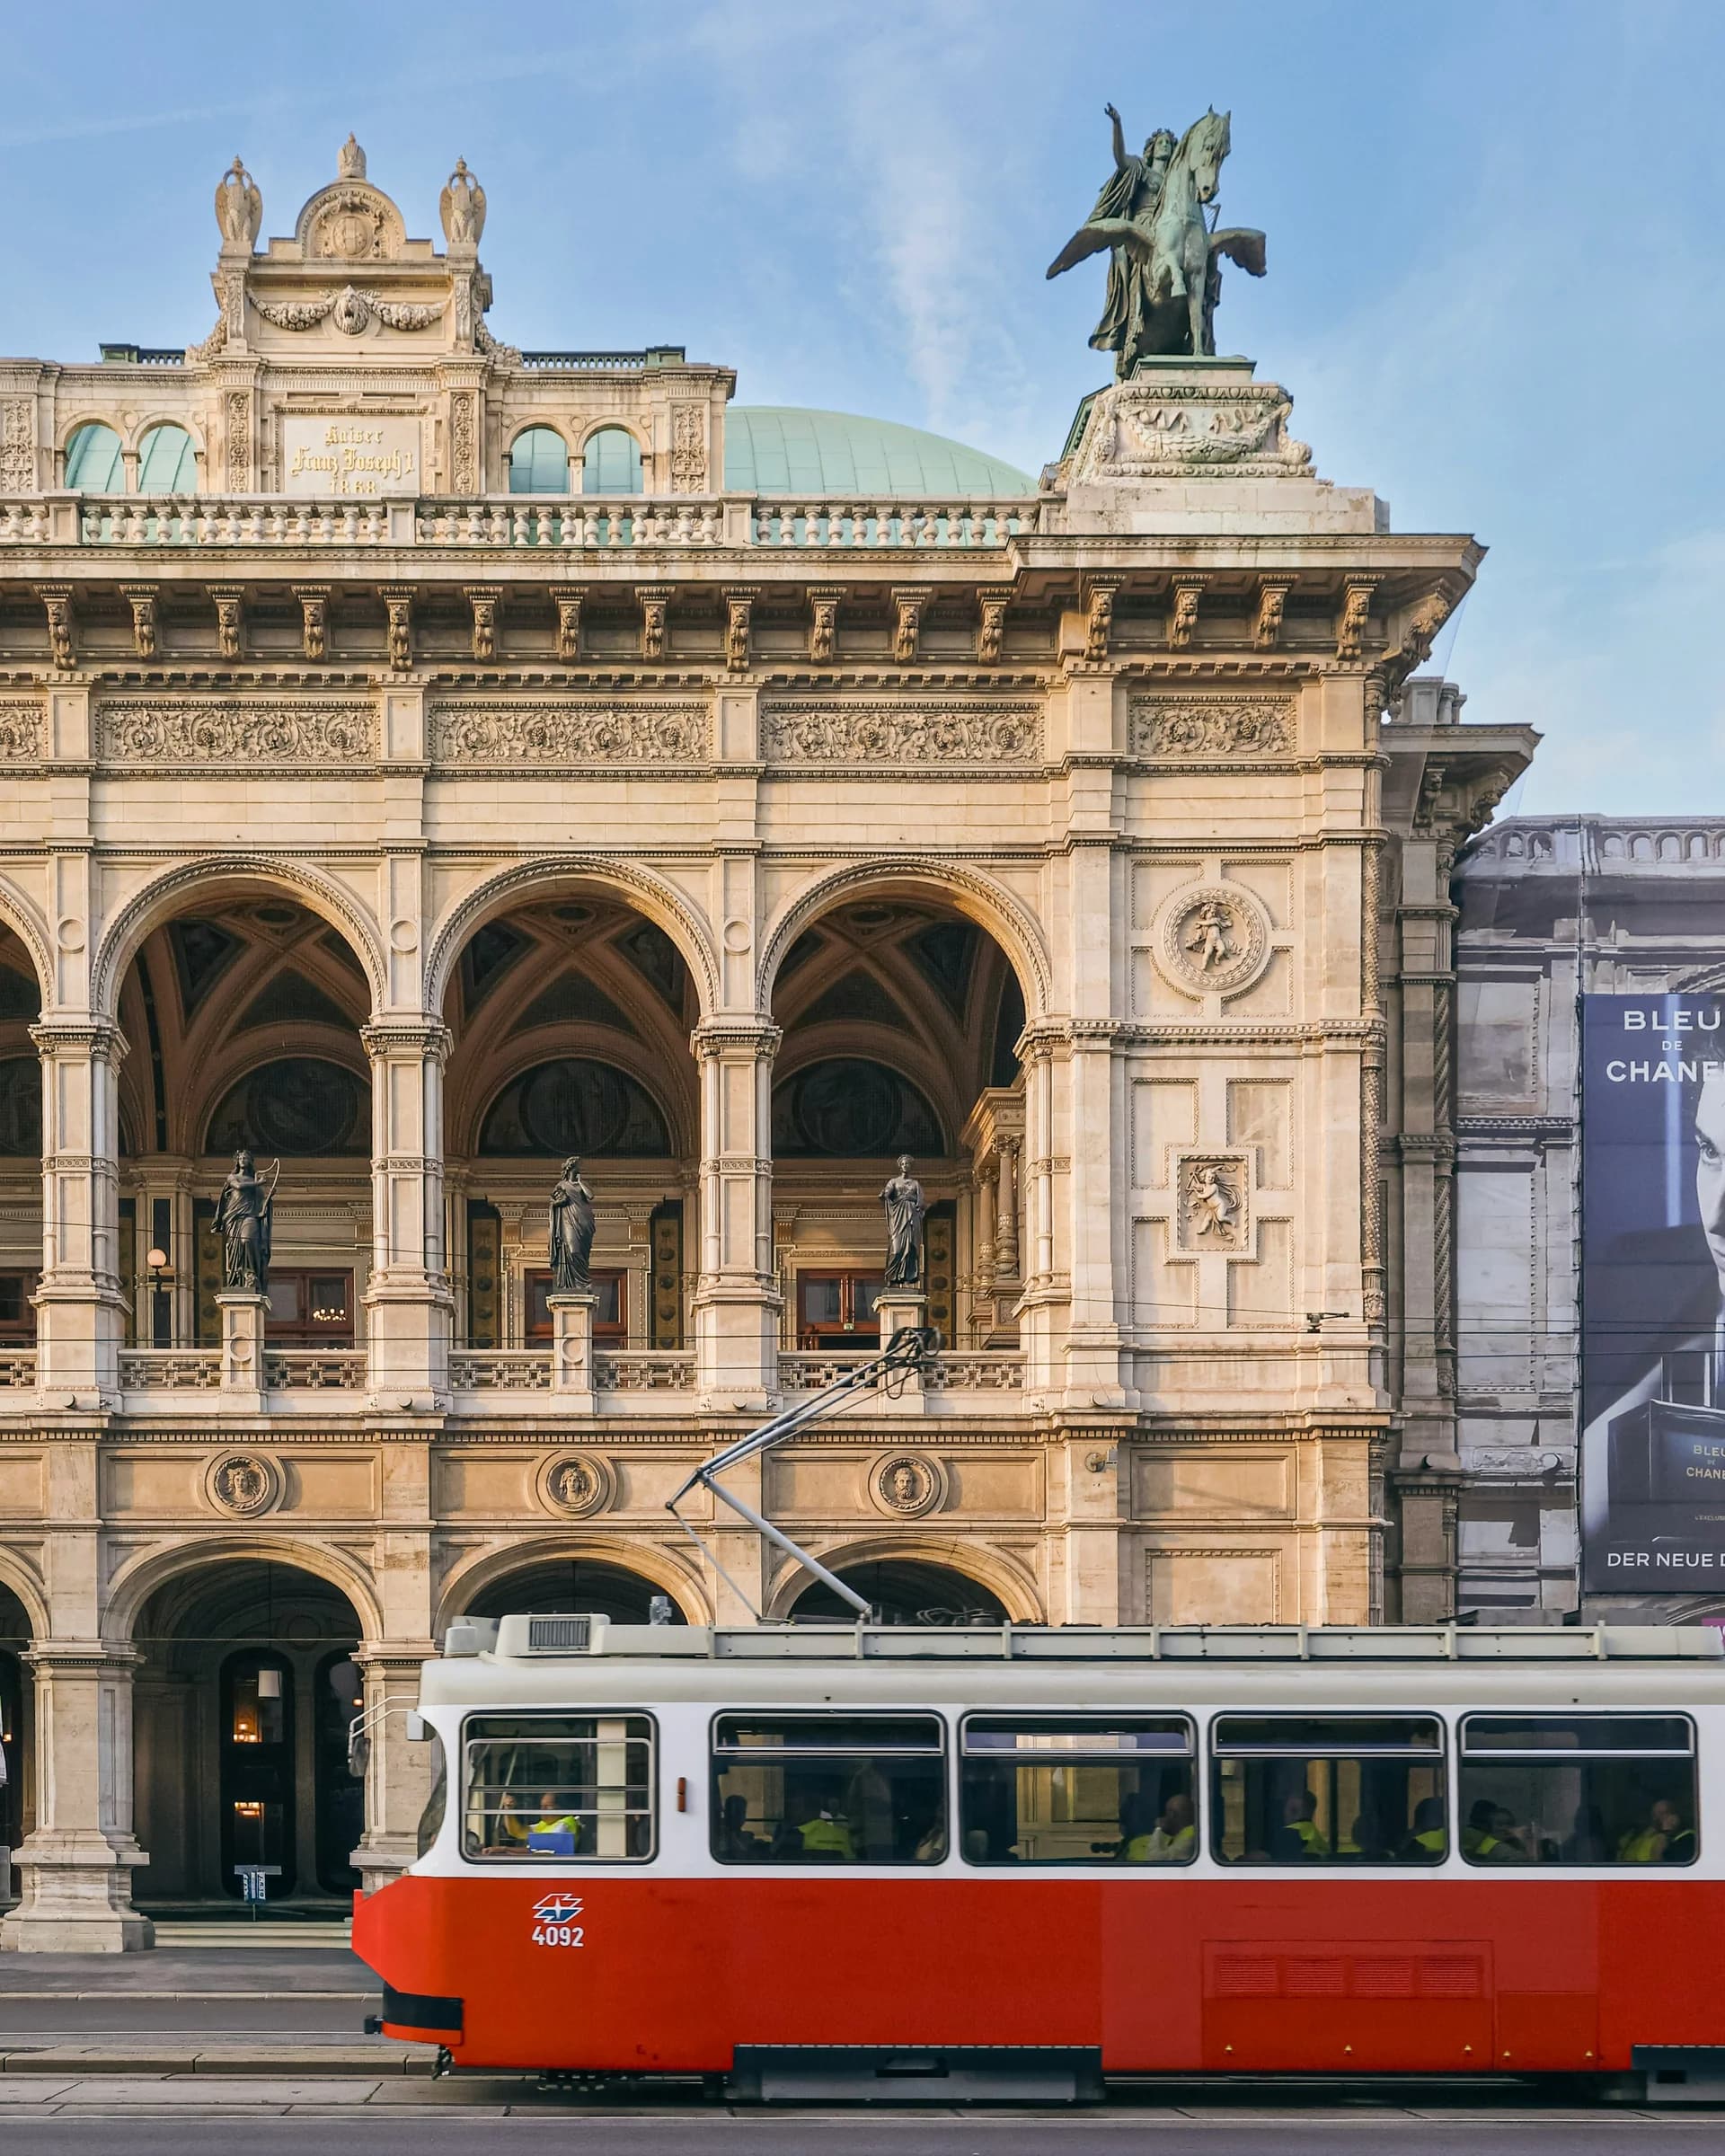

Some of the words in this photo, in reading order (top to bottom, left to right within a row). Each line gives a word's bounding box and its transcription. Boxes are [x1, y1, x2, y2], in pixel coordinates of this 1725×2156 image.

[324, 423, 384, 446] Kaiser
[290, 446, 339, 477] Franz
[342, 447, 402, 480] Joseph
[331, 480, 378, 495] 1868
[1623, 1011, 1721, 1031] BLEU
[1661, 1040, 1683, 1051] DE
[1606, 1060, 1725, 1082] CHANE
[1606, 1552, 1650, 1567] DER
[1656, 1552, 1713, 1568] NEUE
[531, 1926, 585, 1947] 4092
